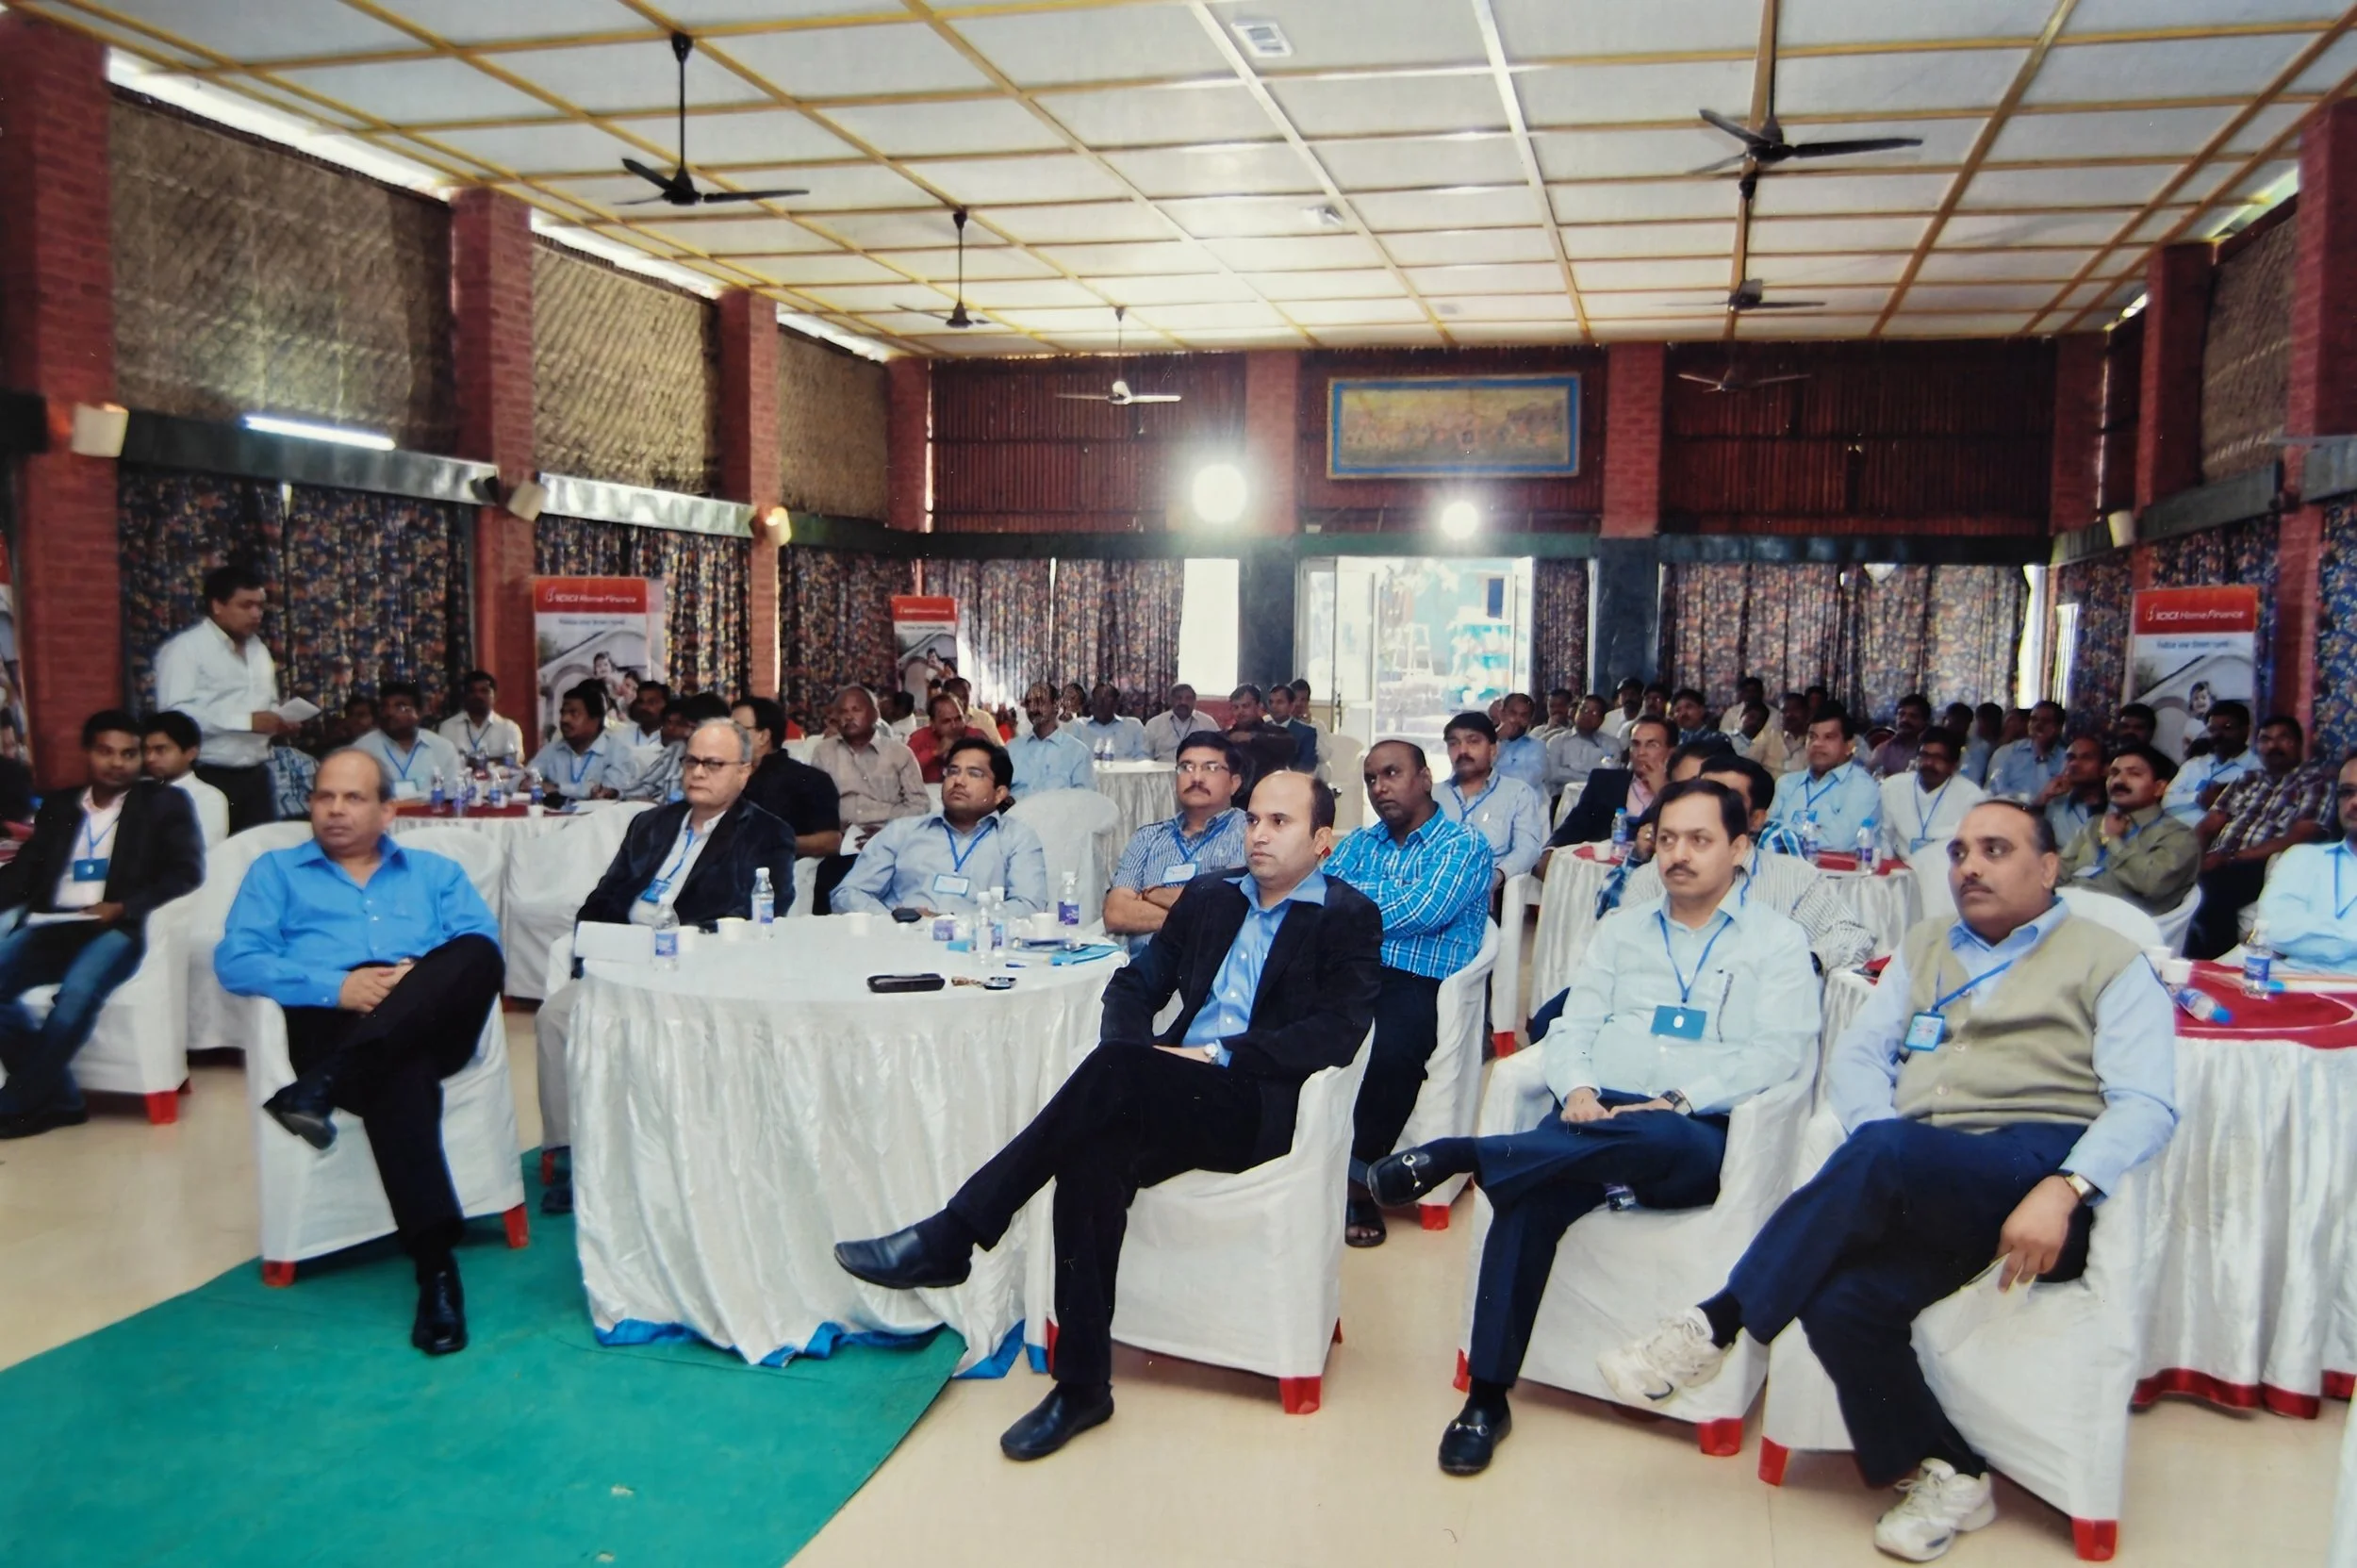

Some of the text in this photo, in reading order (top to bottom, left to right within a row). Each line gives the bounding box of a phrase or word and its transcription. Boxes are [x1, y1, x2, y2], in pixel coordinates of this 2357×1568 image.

[2155, 609, 2245, 621] ICICI Home Finance
